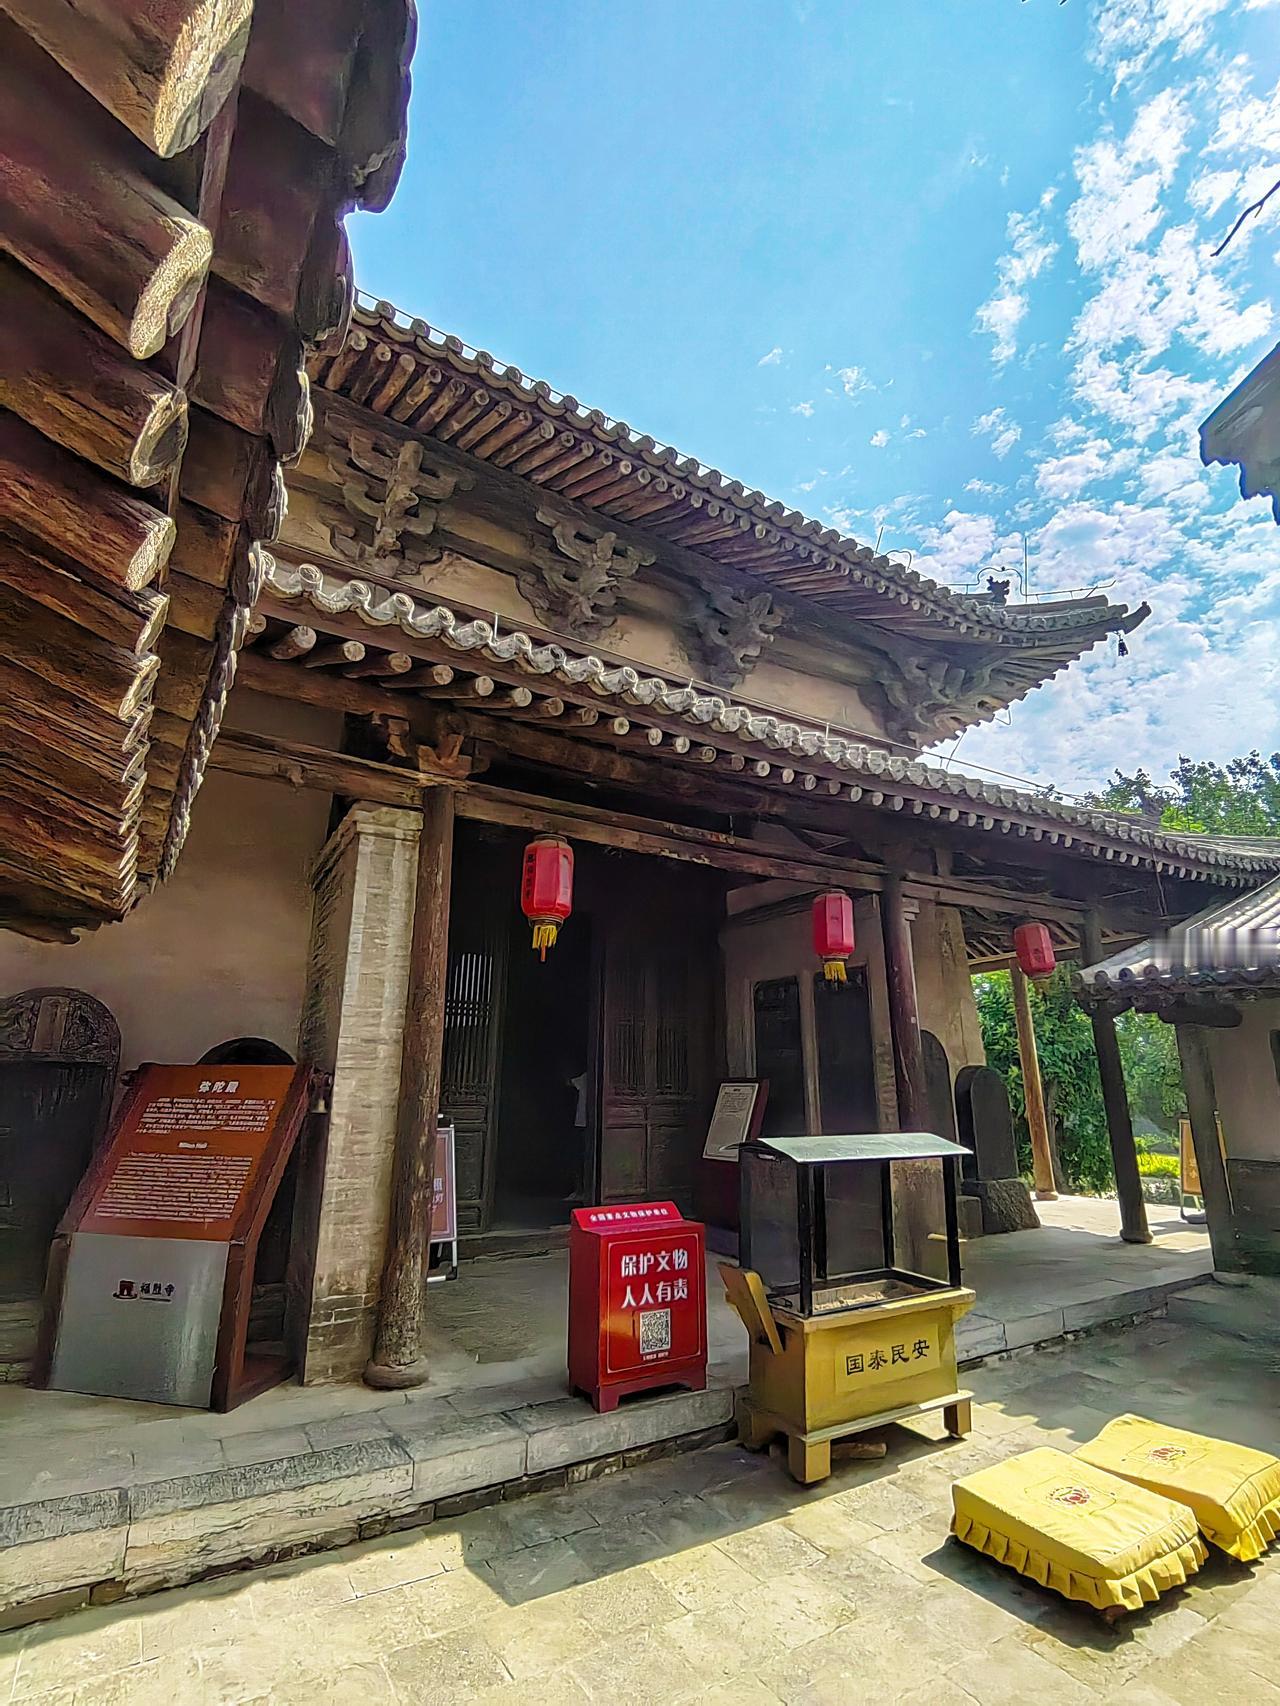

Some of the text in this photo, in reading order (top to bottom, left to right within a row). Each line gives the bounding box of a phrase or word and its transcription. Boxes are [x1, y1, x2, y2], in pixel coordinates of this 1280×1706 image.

[621, 1248, 688, 1278] 保护文物
[621, 1278, 688, 1309] 人人有责
[846, 1339, 930, 1376] 国泰民安
